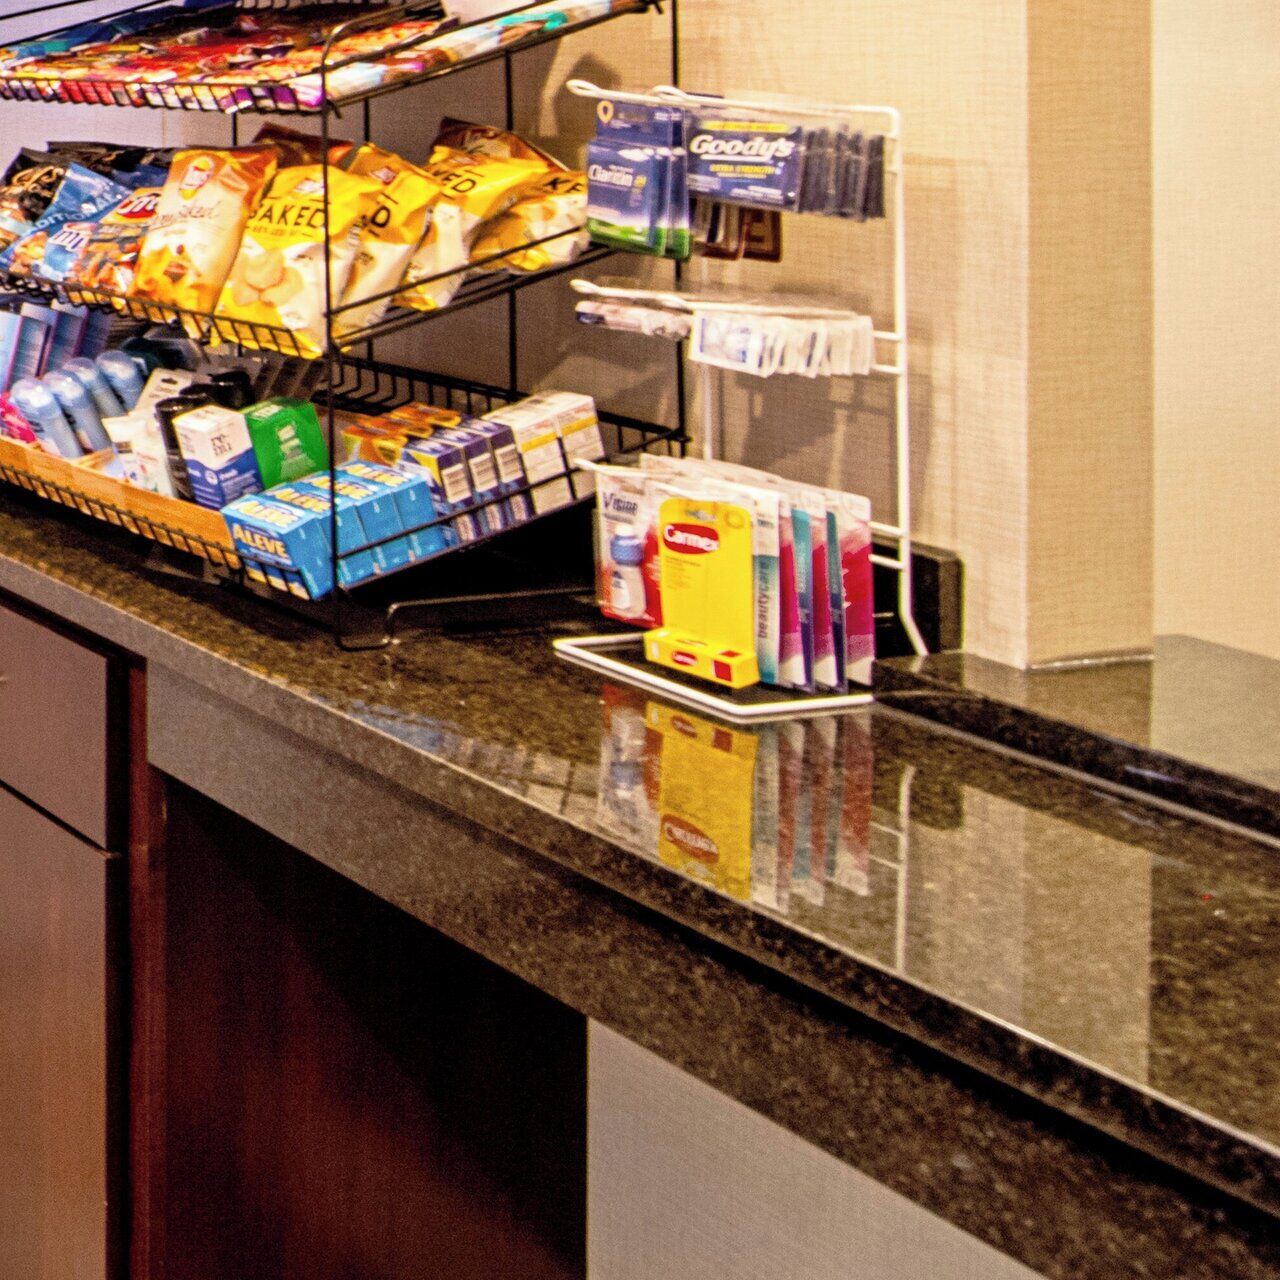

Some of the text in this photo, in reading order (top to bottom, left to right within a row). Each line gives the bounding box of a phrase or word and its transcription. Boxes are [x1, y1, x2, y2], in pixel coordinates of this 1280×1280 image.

[689, 134, 796, 159] Goody's
[588, 163, 634, 187] Claritin
[233, 524, 286, 556] ALEVE
[664, 524, 720, 553] Carmex
